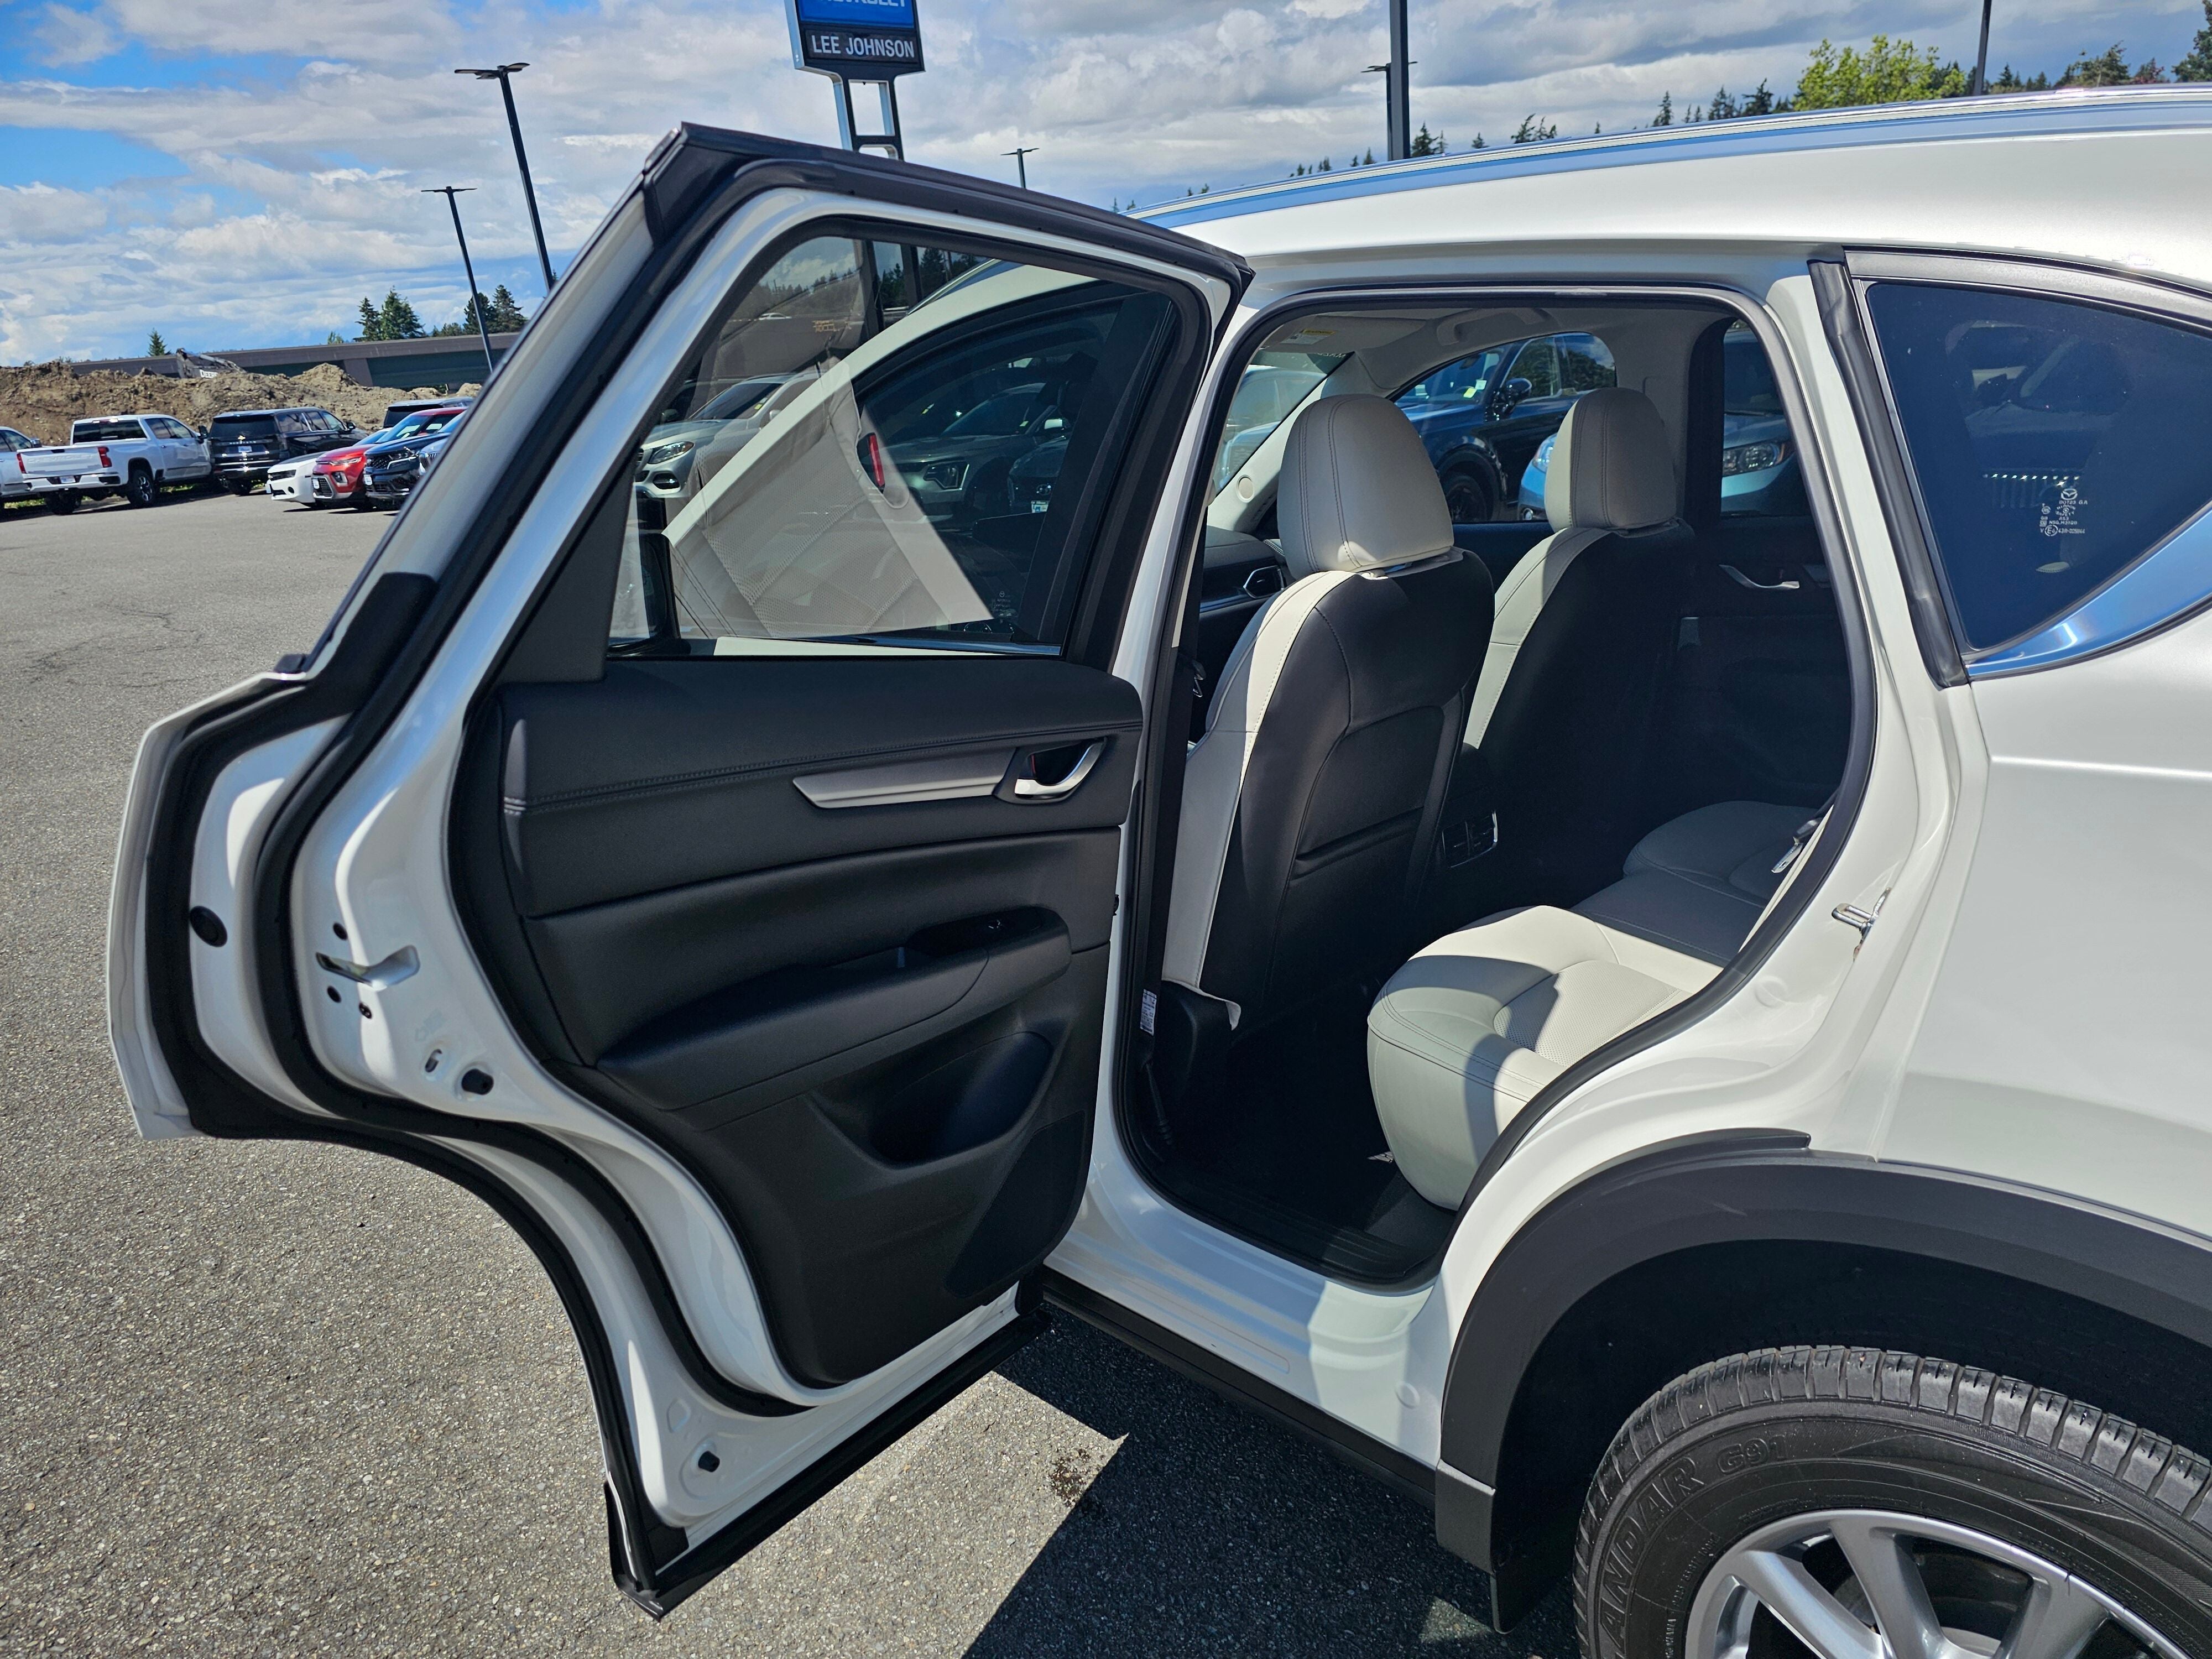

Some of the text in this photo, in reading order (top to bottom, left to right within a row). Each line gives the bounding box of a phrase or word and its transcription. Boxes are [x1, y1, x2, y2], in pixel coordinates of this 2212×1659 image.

[812, 35, 914, 58] LEE JOHNSON
[1716, 1434, 1787, 1474] G91
